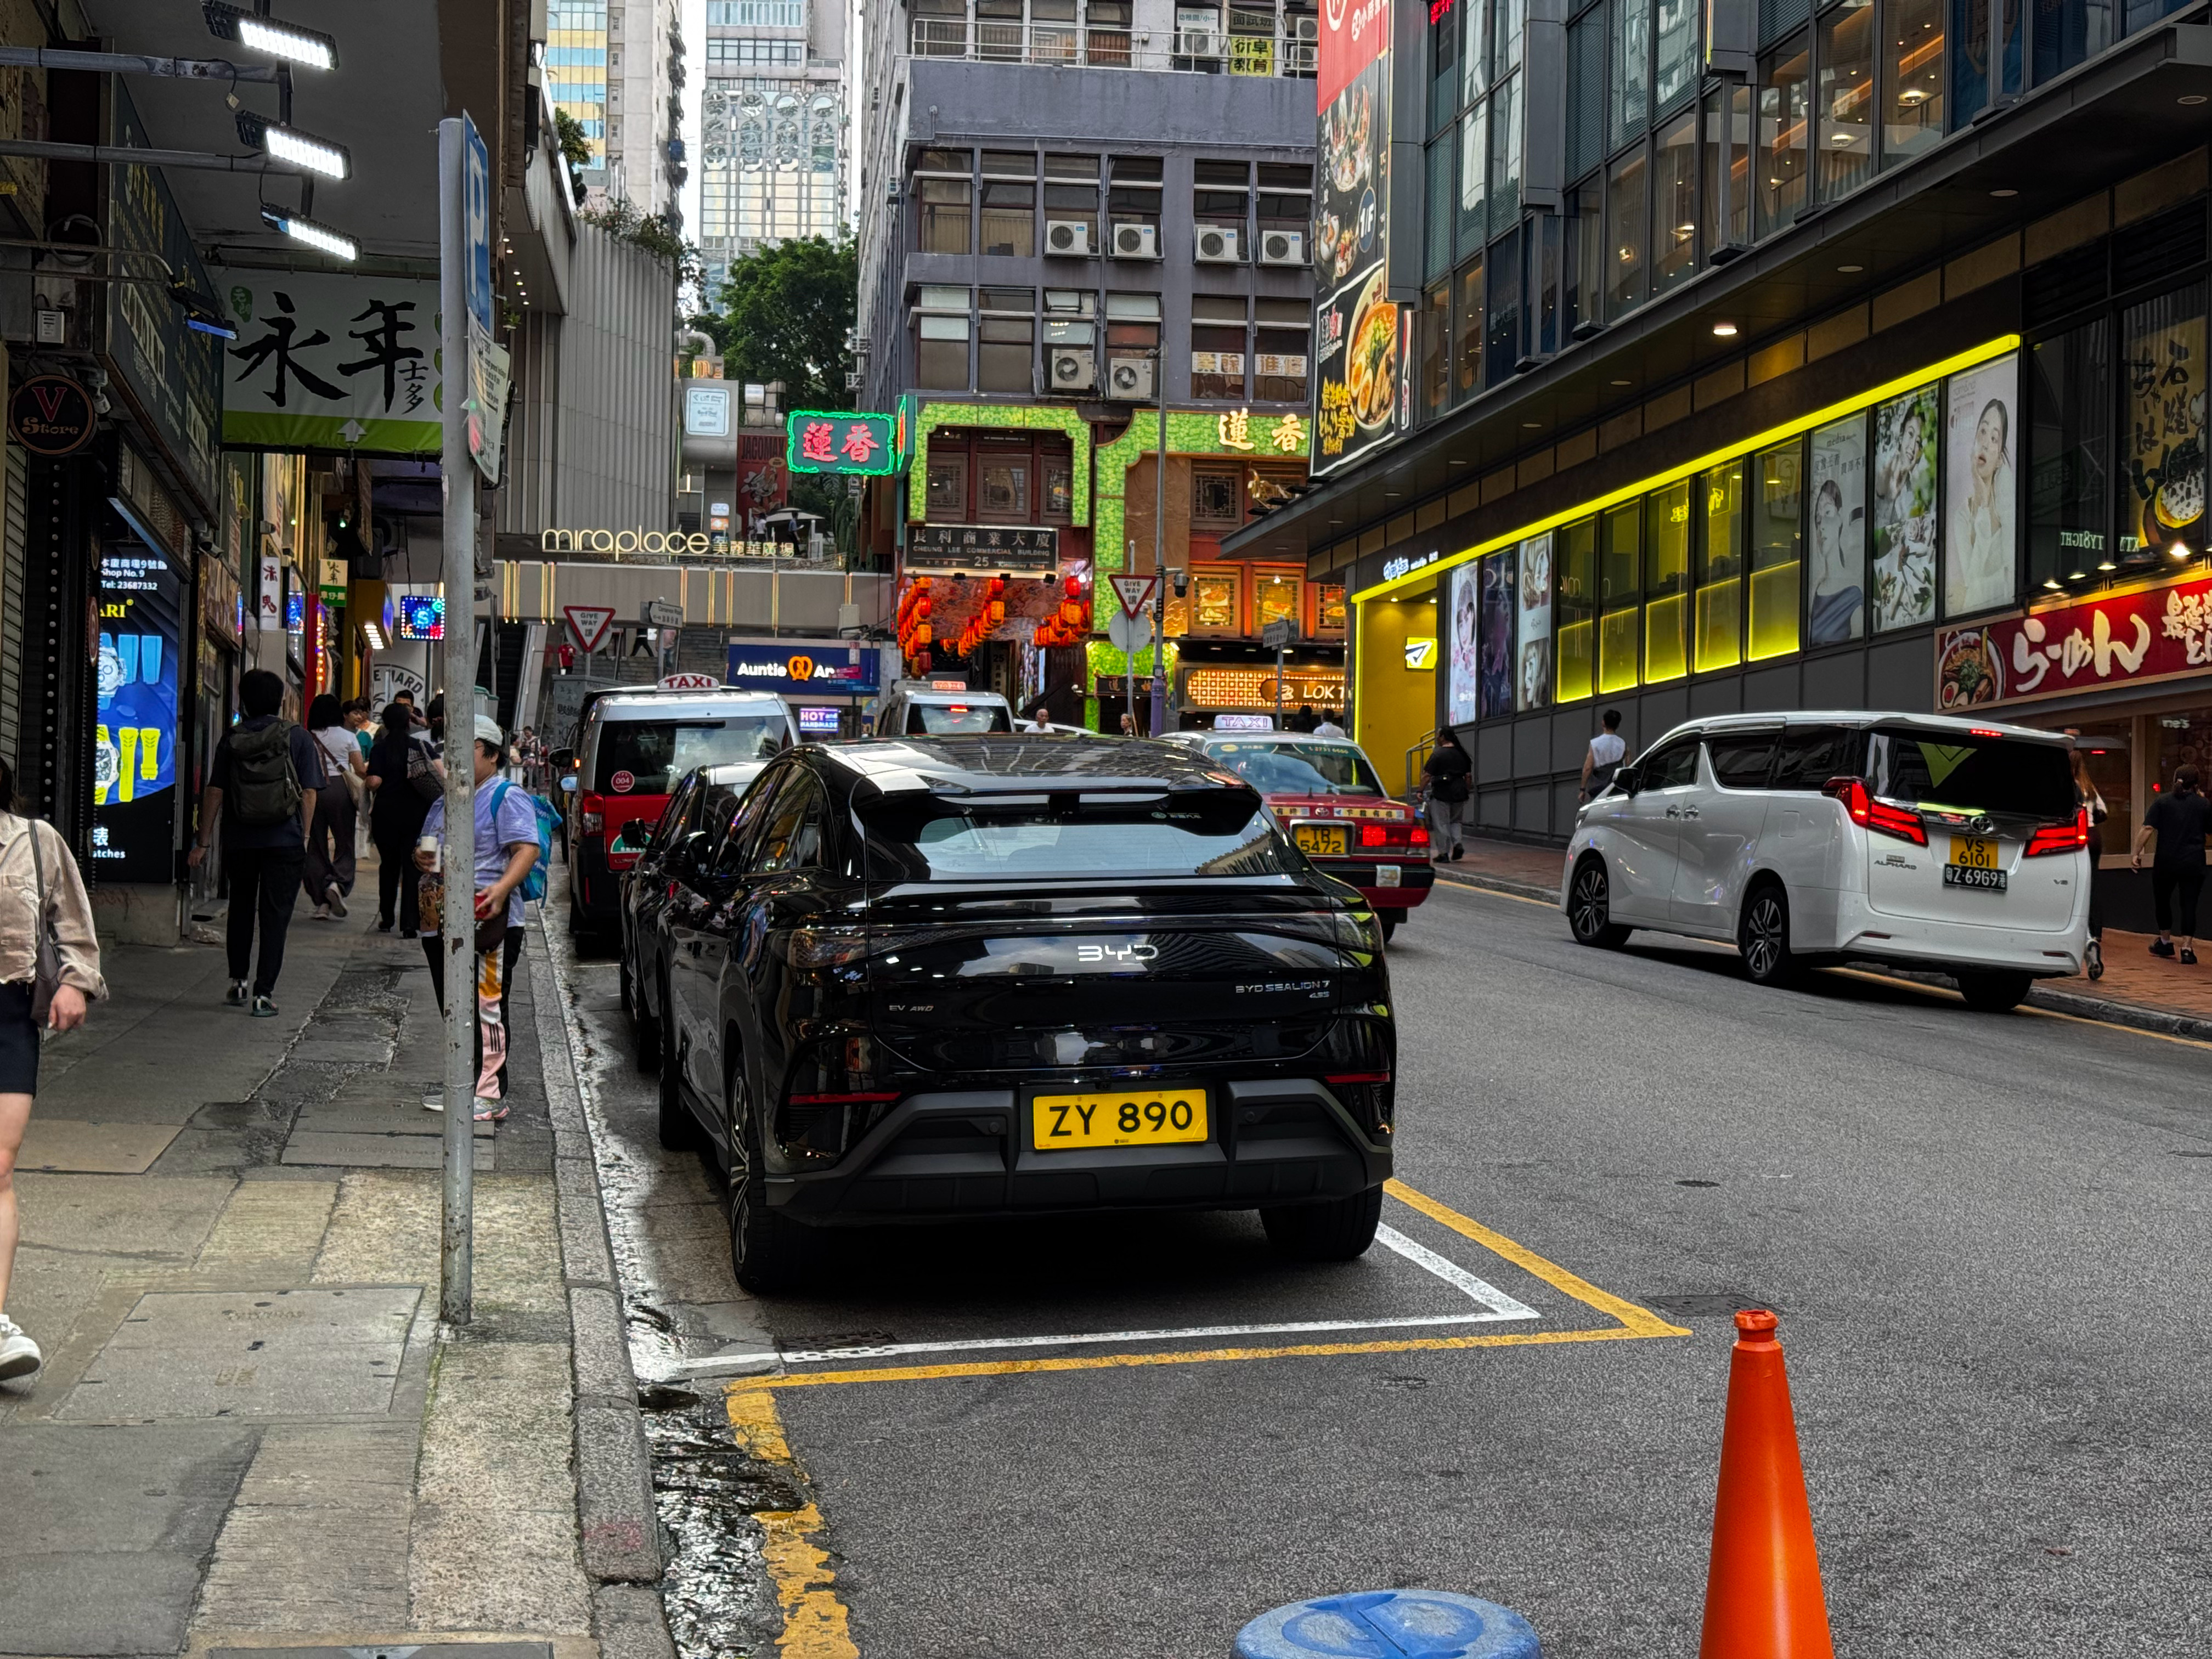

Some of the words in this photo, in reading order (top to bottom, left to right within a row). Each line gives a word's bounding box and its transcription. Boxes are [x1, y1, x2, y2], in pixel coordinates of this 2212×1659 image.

[1234, 15, 1273, 26] 面試班
[470, 141, 485, 298] P
[1359, 203, 1375, 238] 1/F
[227, 291, 424, 414] 永年
[398, 360, 429, 415] 士多
[32, 386, 67, 422] V
[21, 416, 79, 435] Store
[1218, 407, 1306, 452] 蓮香
[803, 422, 879, 462] 蓮香
[543, 525, 709, 561] miraplace
[913, 529, 1051, 548] 長利商業大廈
[966, 547, 1012, 555] COMMERCIAL
[974, 556, 989, 567] 25
[139, 569, 145, 578] 9
[101, 580, 116, 589] Tel:
[117, 581, 158, 591] 23687332
[2013, 610, 2150, 692] らーめん
[737, 663, 787, 676] Auntie
[664, 675, 712, 689] TAXI
[1304, 685, 1335, 699] LOK
[801, 712, 825, 720] HOT
[1221, 717, 1268, 728] TAXI
[1300, 840, 1341, 853] 5472
[1964, 839, 1985, 853] VS
[1959, 854, 1990, 867] 6101
[1077, 945, 1158, 961] BYD
[1265, 982, 1320, 992] SEALION
[1049, 1105, 1097, 1138] ZY
[1118, 1099, 1193, 1133] 890
